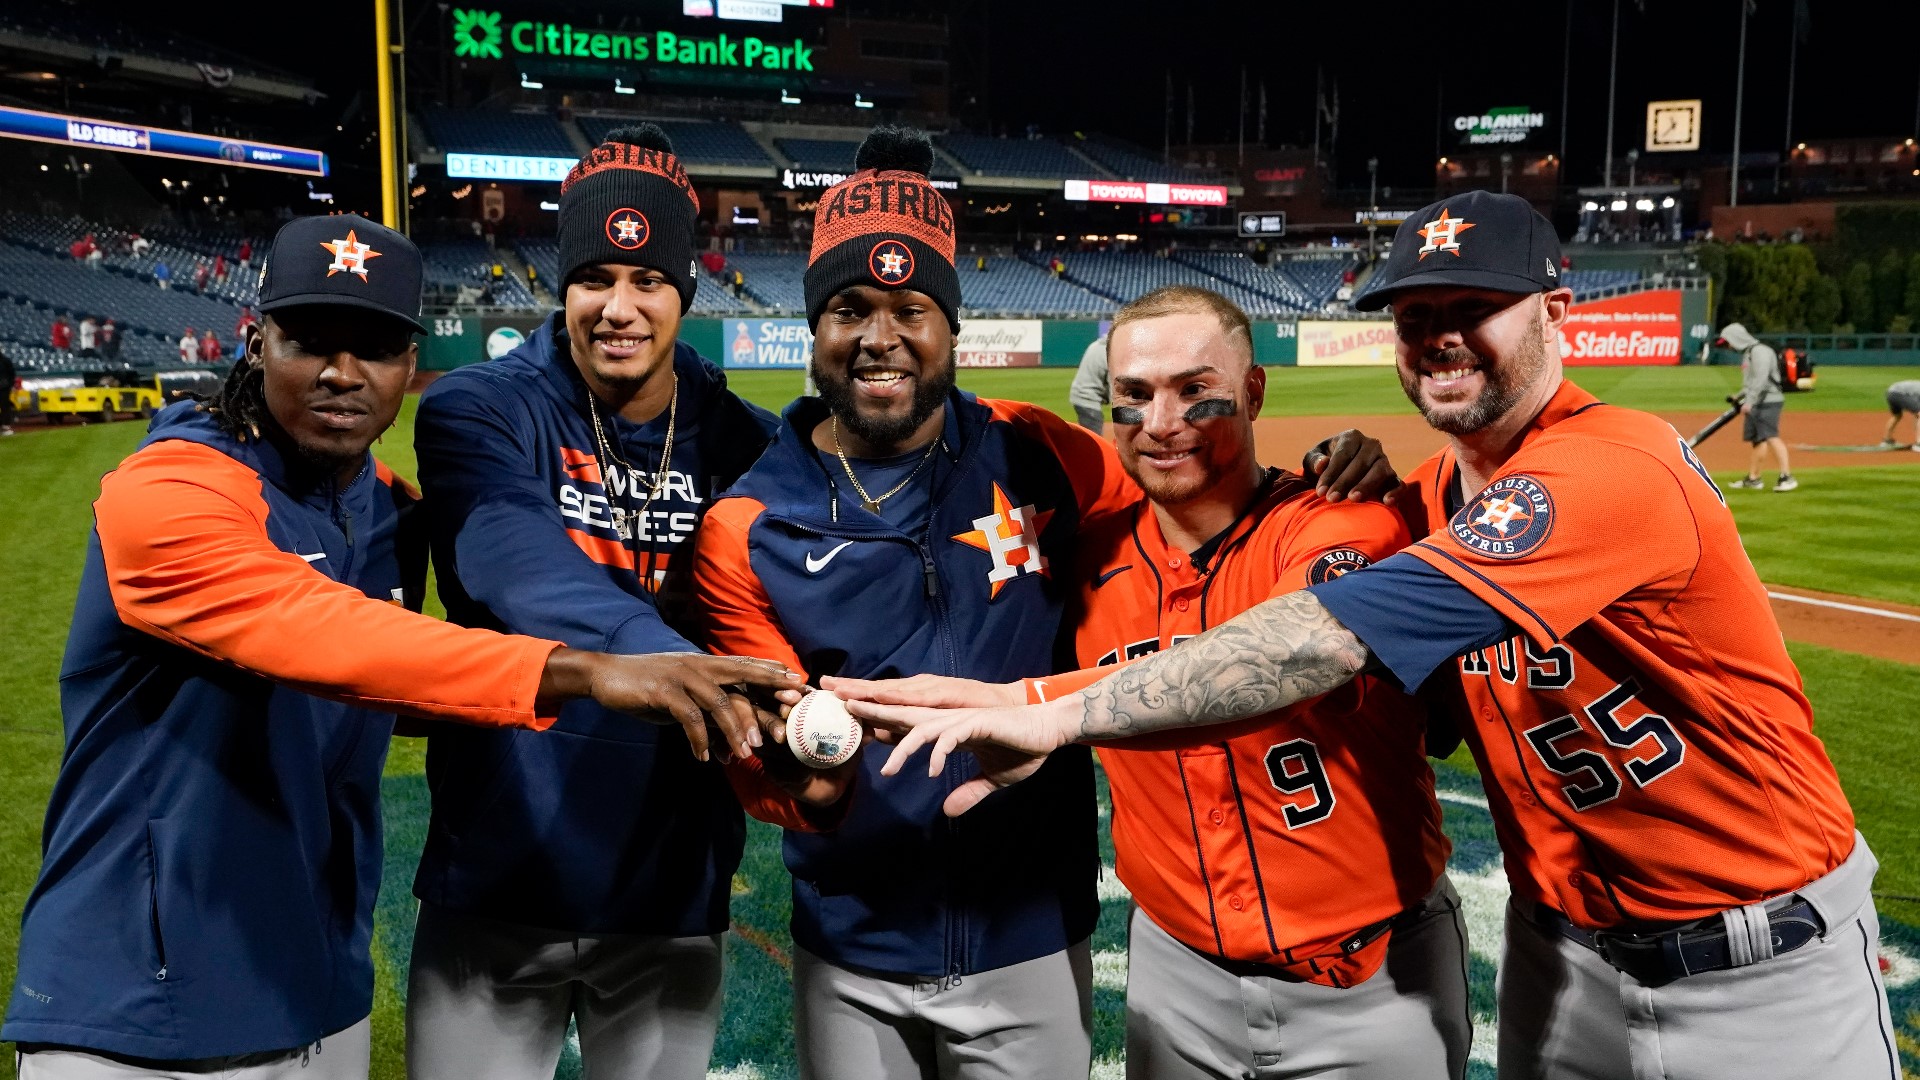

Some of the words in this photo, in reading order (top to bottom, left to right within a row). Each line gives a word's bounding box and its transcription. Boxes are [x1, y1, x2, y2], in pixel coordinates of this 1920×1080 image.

[511, 21, 649, 60] Citizens
[657, 31, 738, 66] Bank
[744, 37, 814, 72] Park
[1454, 115, 1480, 130] CP
[93, 126, 138, 148] SERIES
[1470, 132, 1527, 144] ROOFTOP
[1090, 184, 1145, 199] TOYOTA
[1171, 188, 1223, 203] TOYOTA
[825, 179, 955, 236] ASTROS
[1418, 217, 1464, 255] H
[328, 239, 371, 275] H
[758, 321, 814, 342] SHER
[958, 324, 1028, 350] uengling
[1276, 323, 1297, 339] 374
[758, 343, 809, 364] WILL
[957, 352, 1008, 367] LAGER
[1483, 478, 1548, 513] HOUSTON
[971, 504, 1049, 584] H
[1454, 523, 1515, 553] ASTROS
[1522, 675, 1687, 813] 55
[1262, 737, 1337, 831] 9
